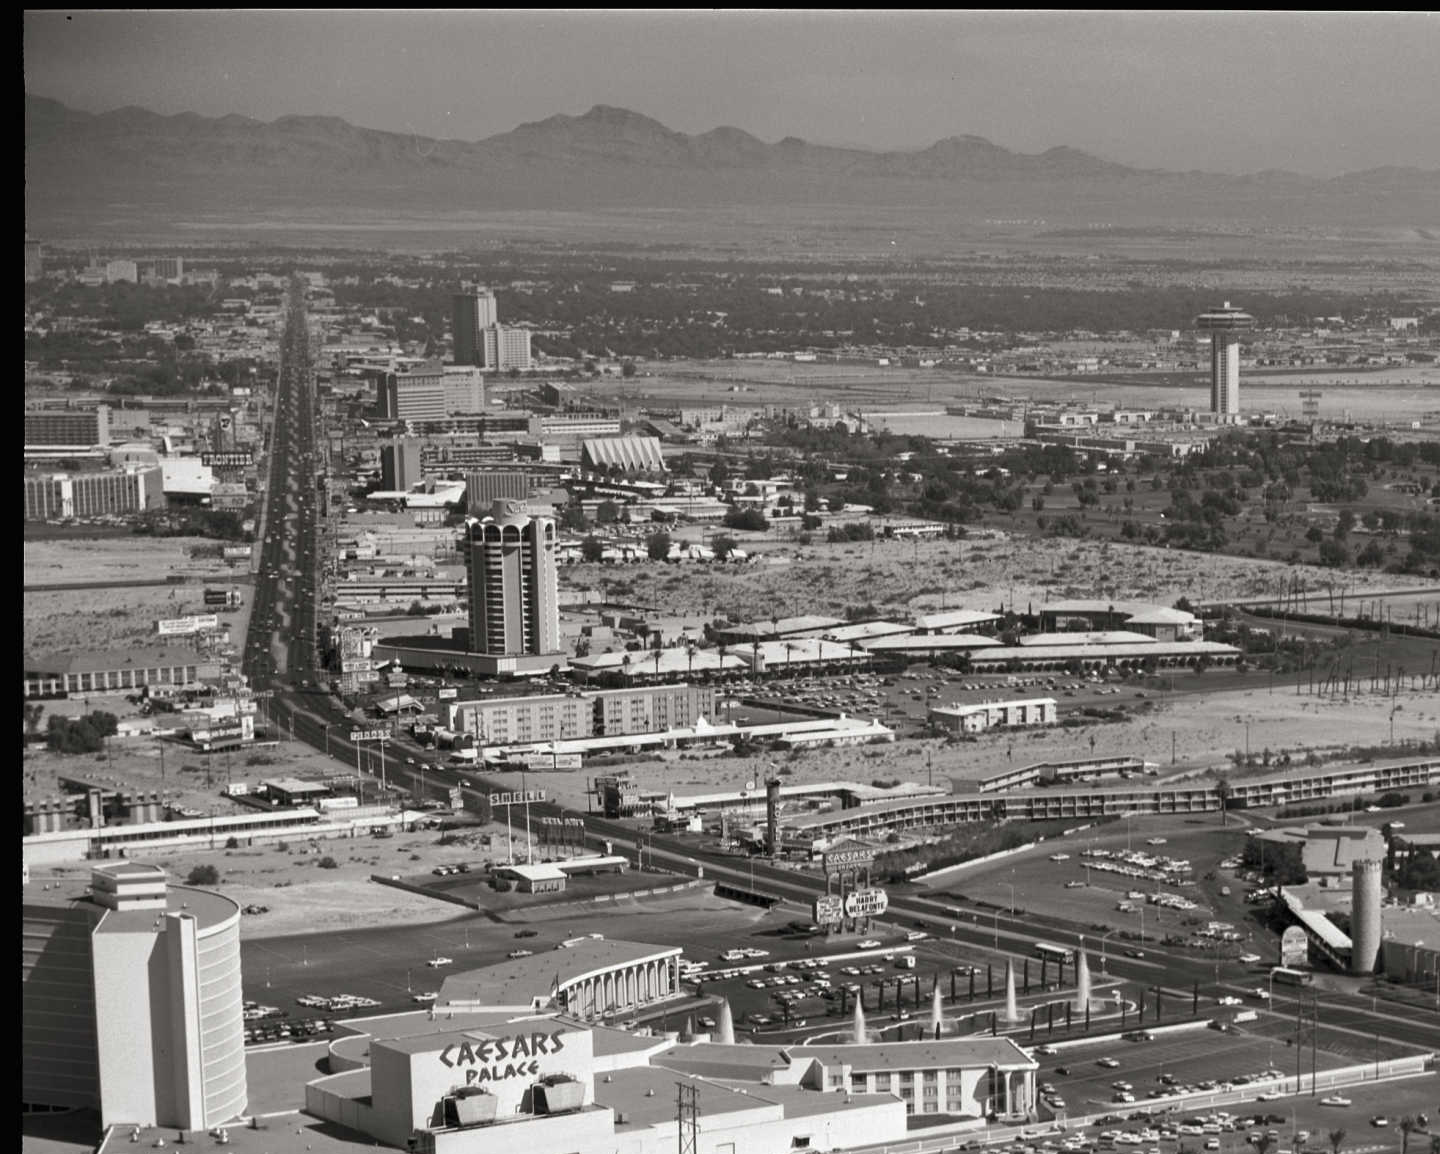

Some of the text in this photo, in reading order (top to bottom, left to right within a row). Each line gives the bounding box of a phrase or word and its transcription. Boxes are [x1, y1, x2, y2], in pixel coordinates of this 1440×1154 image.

[203, 453, 253, 465] FRONTIER
[490, 791, 545, 804] SHELL
[828, 850, 873, 863] CAESARS
[439, 1028, 566, 1068] CAESARS
[465, 1060, 540, 1085] PALACE
